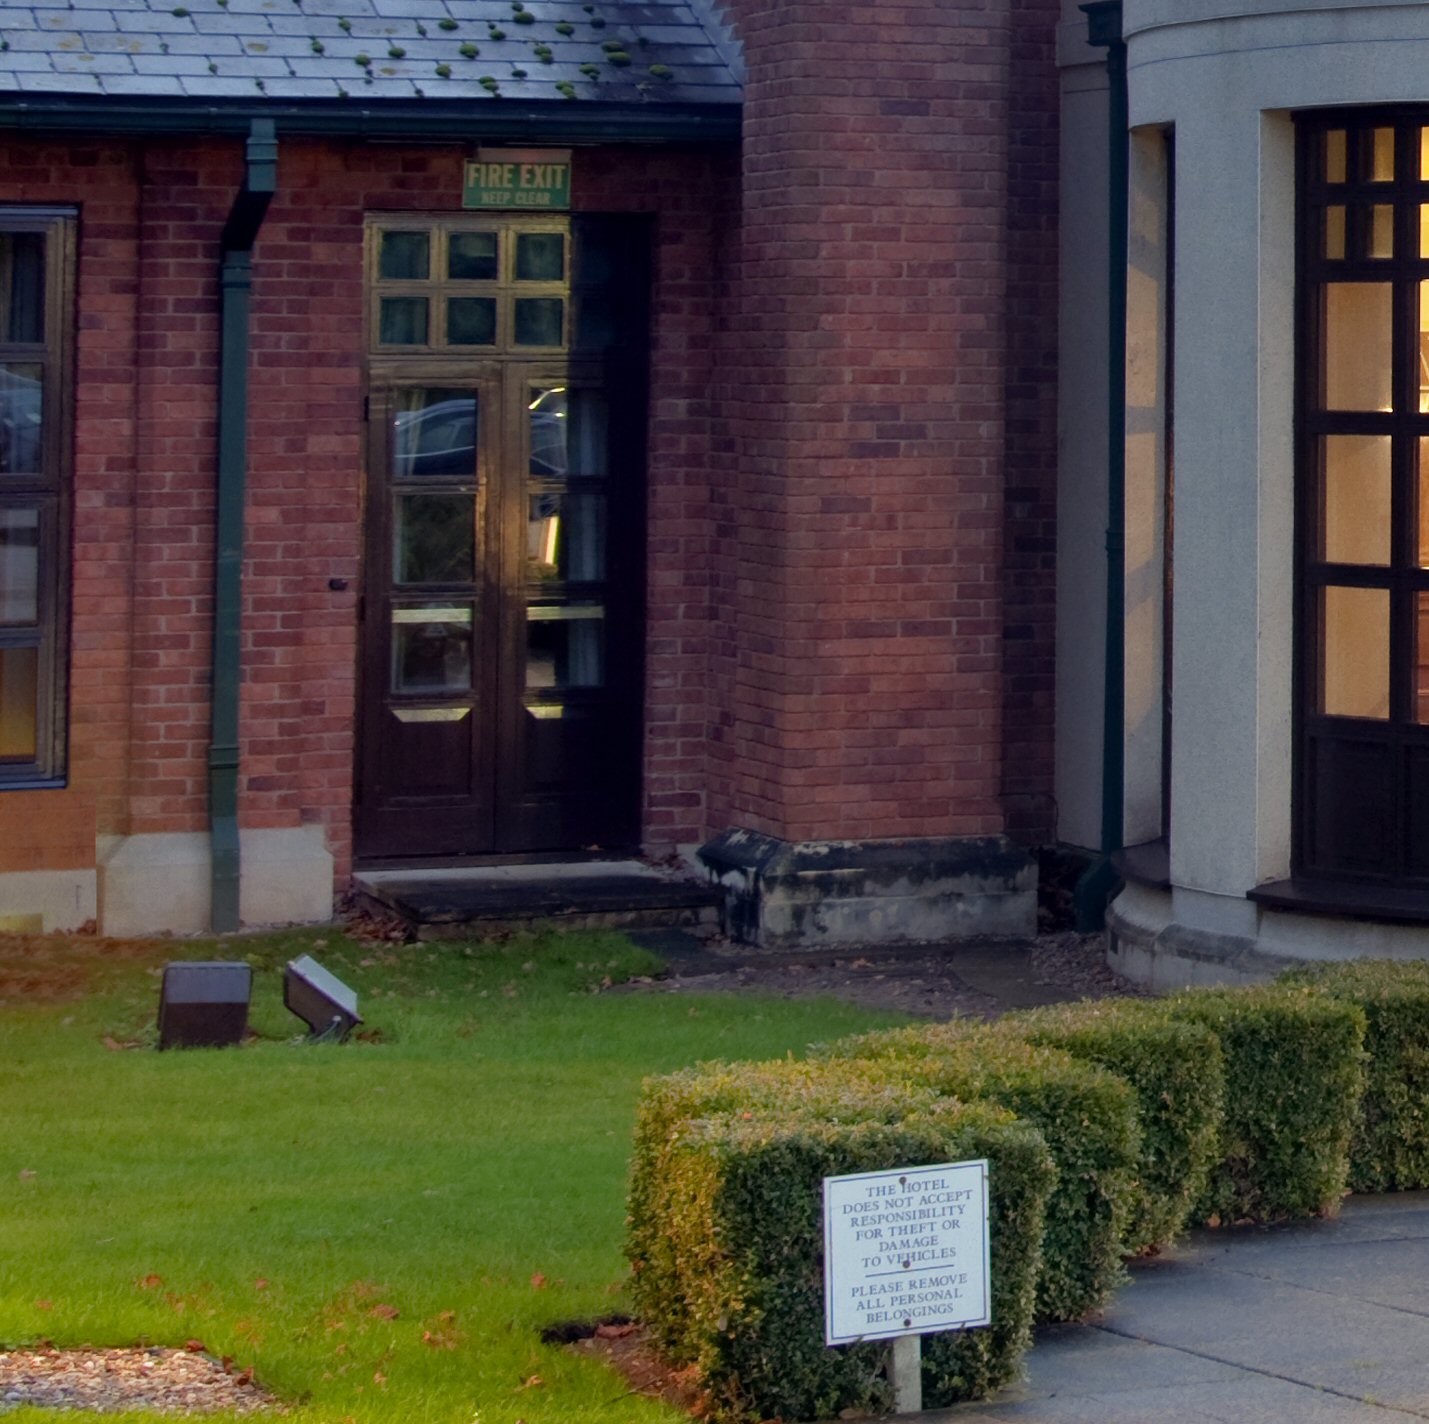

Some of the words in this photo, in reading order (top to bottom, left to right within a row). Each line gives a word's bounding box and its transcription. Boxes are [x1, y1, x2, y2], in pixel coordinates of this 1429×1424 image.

[468, 164, 514, 188] FIRE
[520, 165, 566, 189] EXIT
[515, 192, 550, 205] CLEAR
[866, 1185, 895, 1197] THE
[902, 1179, 949, 1193] HOTEL
[843, 1201, 879, 1214] DOES
[885, 1197, 913, 1209] NOT
[920, 1190, 973, 1204] ACCEPT
[851, 1205, 966, 1227] RESPONSIBILITY
[856, 1229, 883, 1241] FOR
[888, 1223, 936, 1237] THEFT
[942, 1220, 960, 1230] OR
[879, 1236, 939, 1252] DAMAGE
[862, 1257, 881, 1267] TO
[887, 1248, 956, 1264] VEHICLES
[851, 1282, 903, 1297] PLEASE
[909, 1273, 967, 1288] REMOVE
[857, 1298, 885, 1311] ALL
[890, 1288, 963, 1306] PERSONAL
[867, 1304, 953, 1323] BELONGINGS
